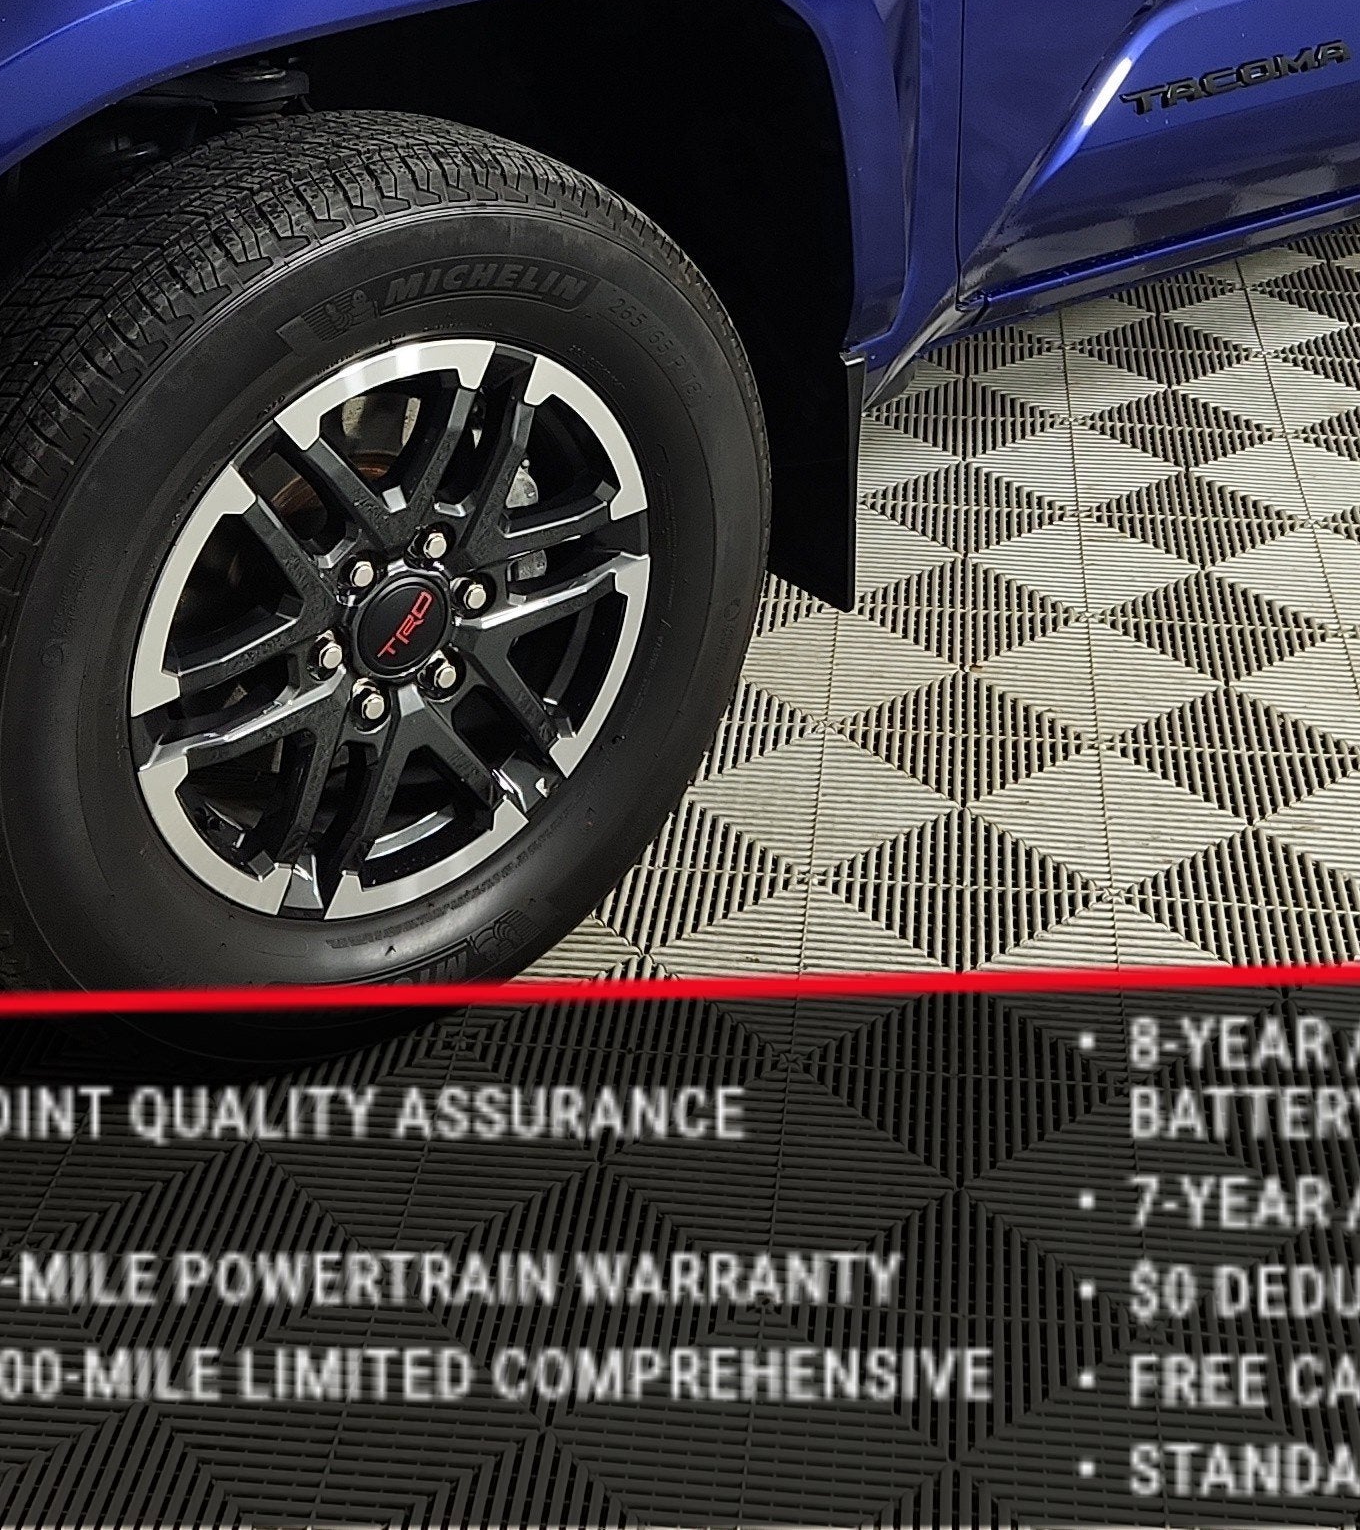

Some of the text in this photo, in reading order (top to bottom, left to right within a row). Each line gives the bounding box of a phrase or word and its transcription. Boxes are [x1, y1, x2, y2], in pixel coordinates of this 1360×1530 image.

[1119, 39, 1351, 116] TACOMA
[384, 263, 590, 307] MICHELIN
[377, 591, 433, 658] TRD
